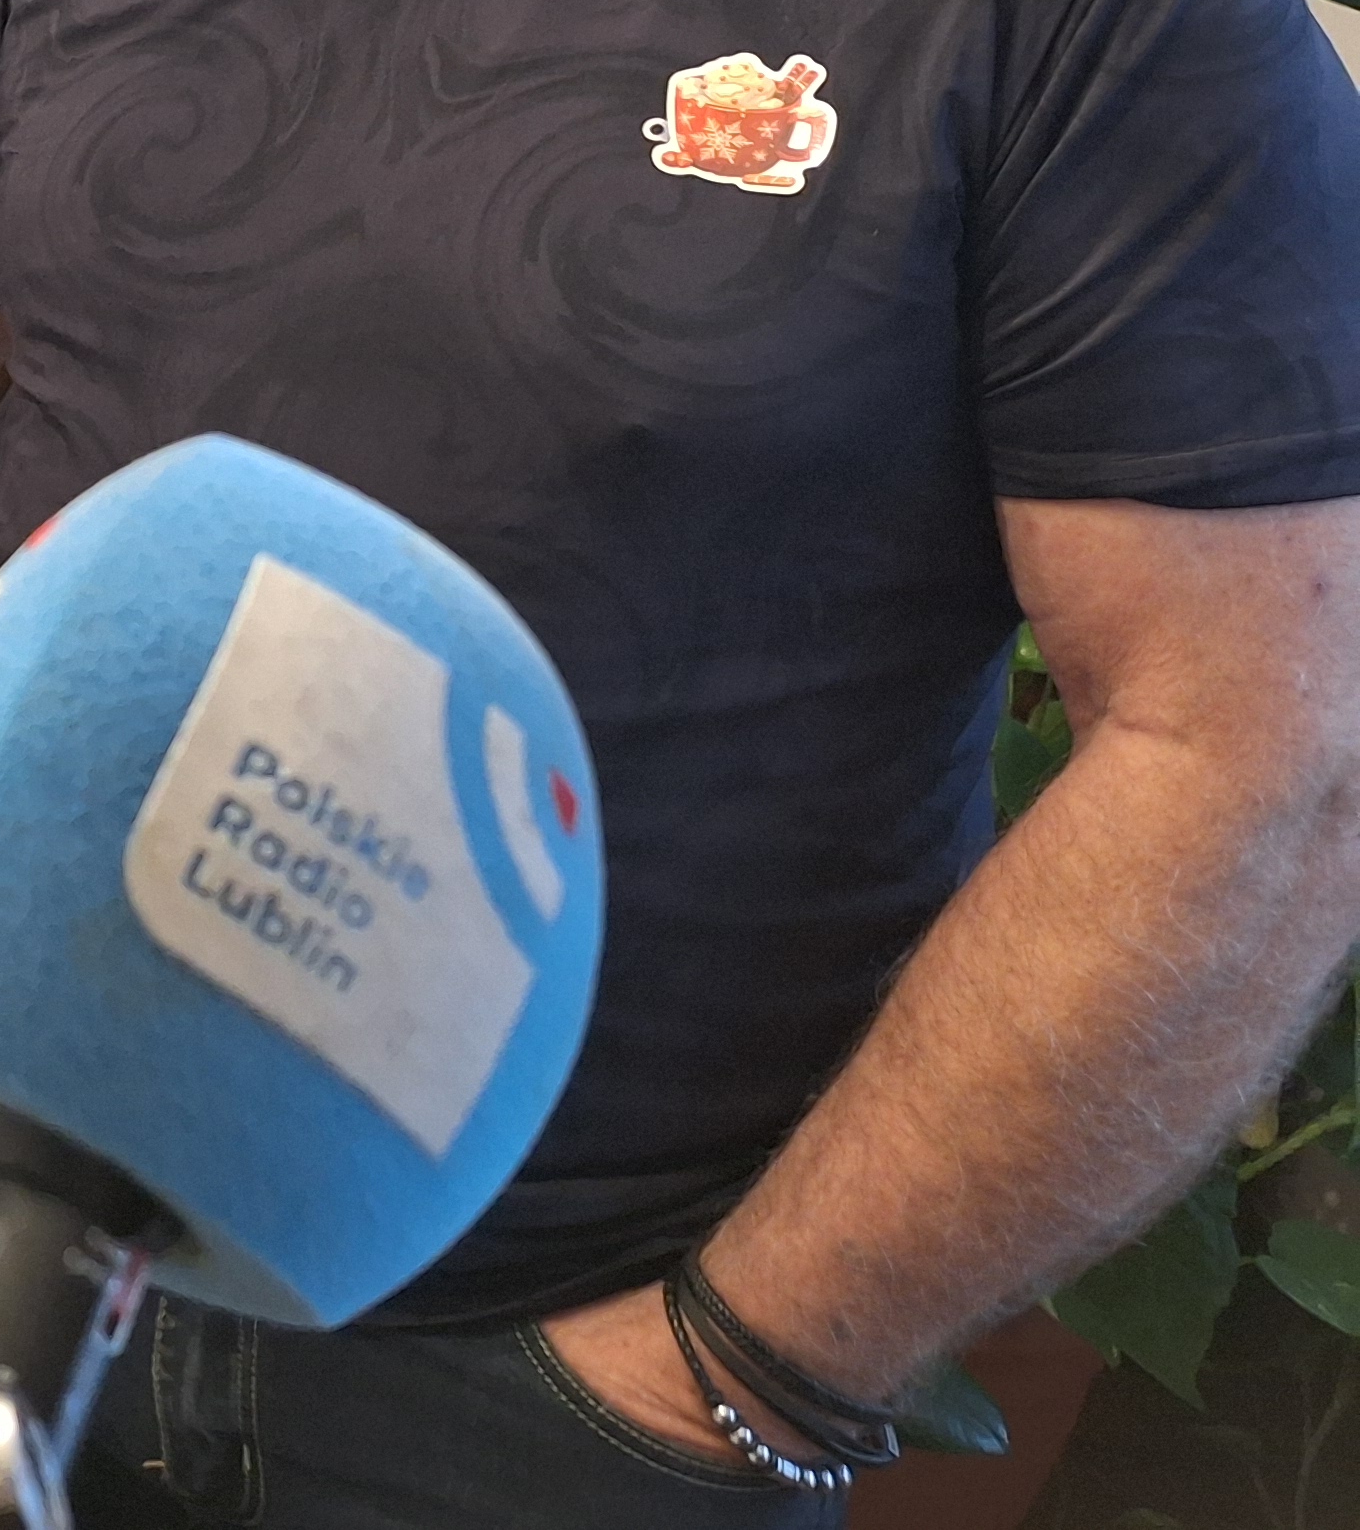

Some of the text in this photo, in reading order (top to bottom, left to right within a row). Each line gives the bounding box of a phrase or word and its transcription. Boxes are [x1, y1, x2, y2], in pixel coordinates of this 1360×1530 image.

[209, 793, 374, 931] Radio
[237, 742, 431, 904] Polskie
[182, 848, 359, 992] Lublin
